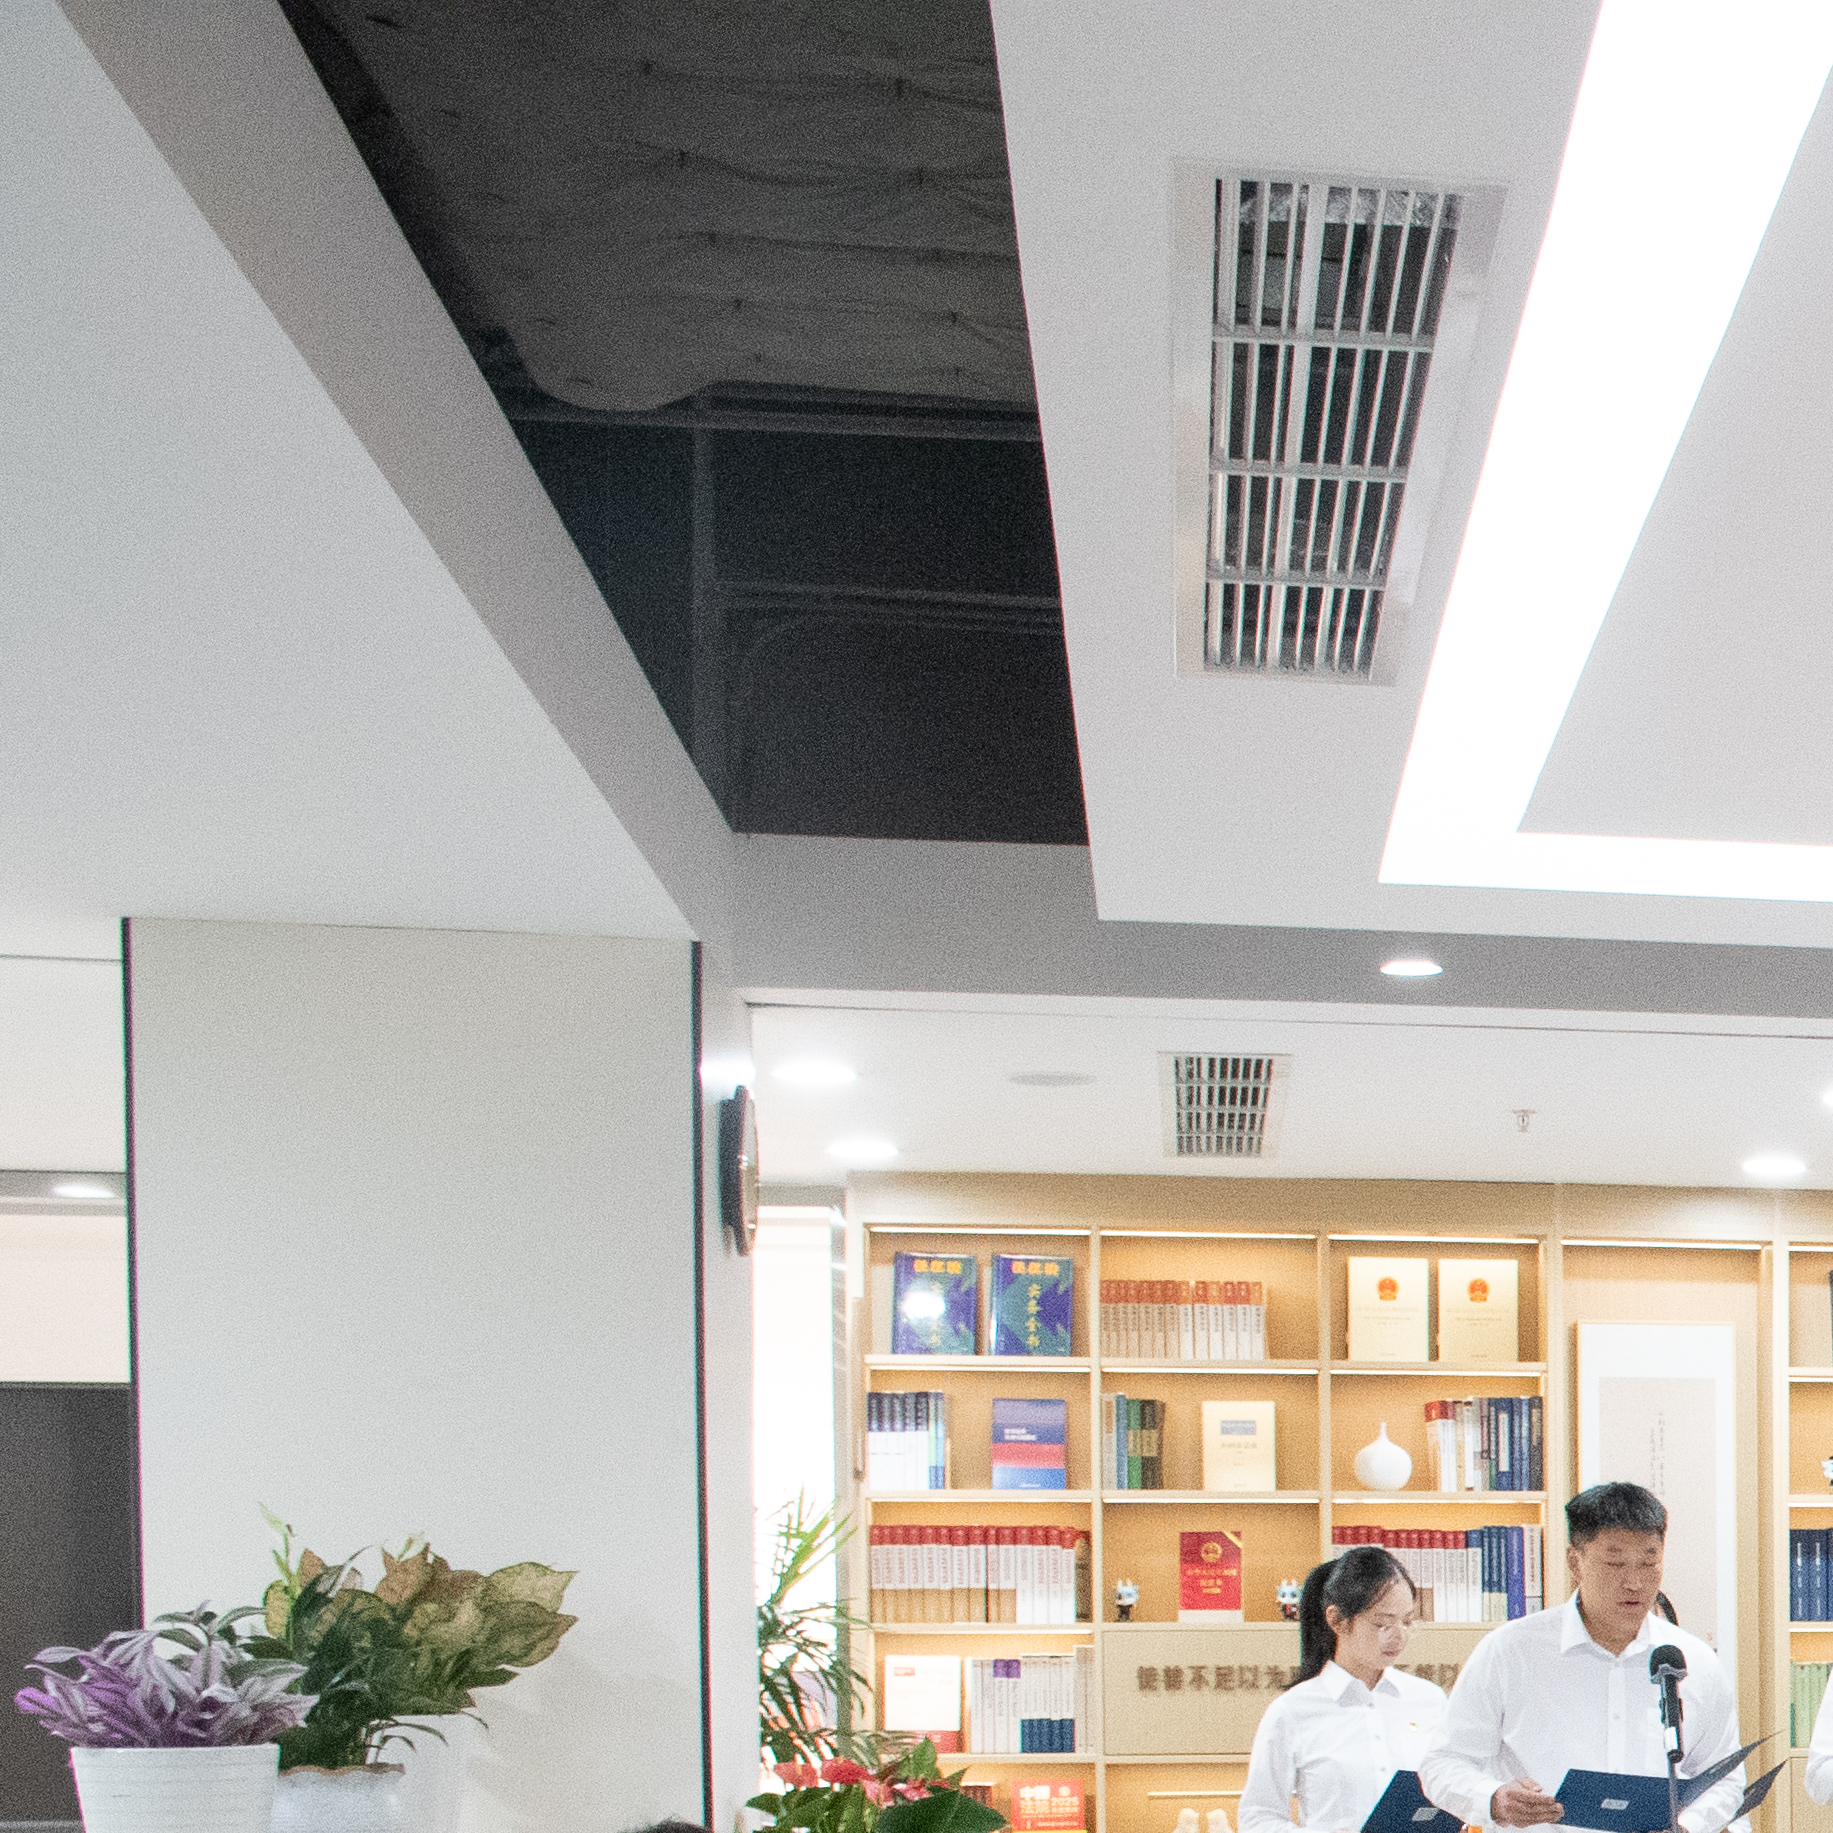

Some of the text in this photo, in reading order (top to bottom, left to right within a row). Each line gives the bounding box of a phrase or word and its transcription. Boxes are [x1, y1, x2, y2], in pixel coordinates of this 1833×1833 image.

[1136, 1663, 1299, 1691] 徒善不足以为
